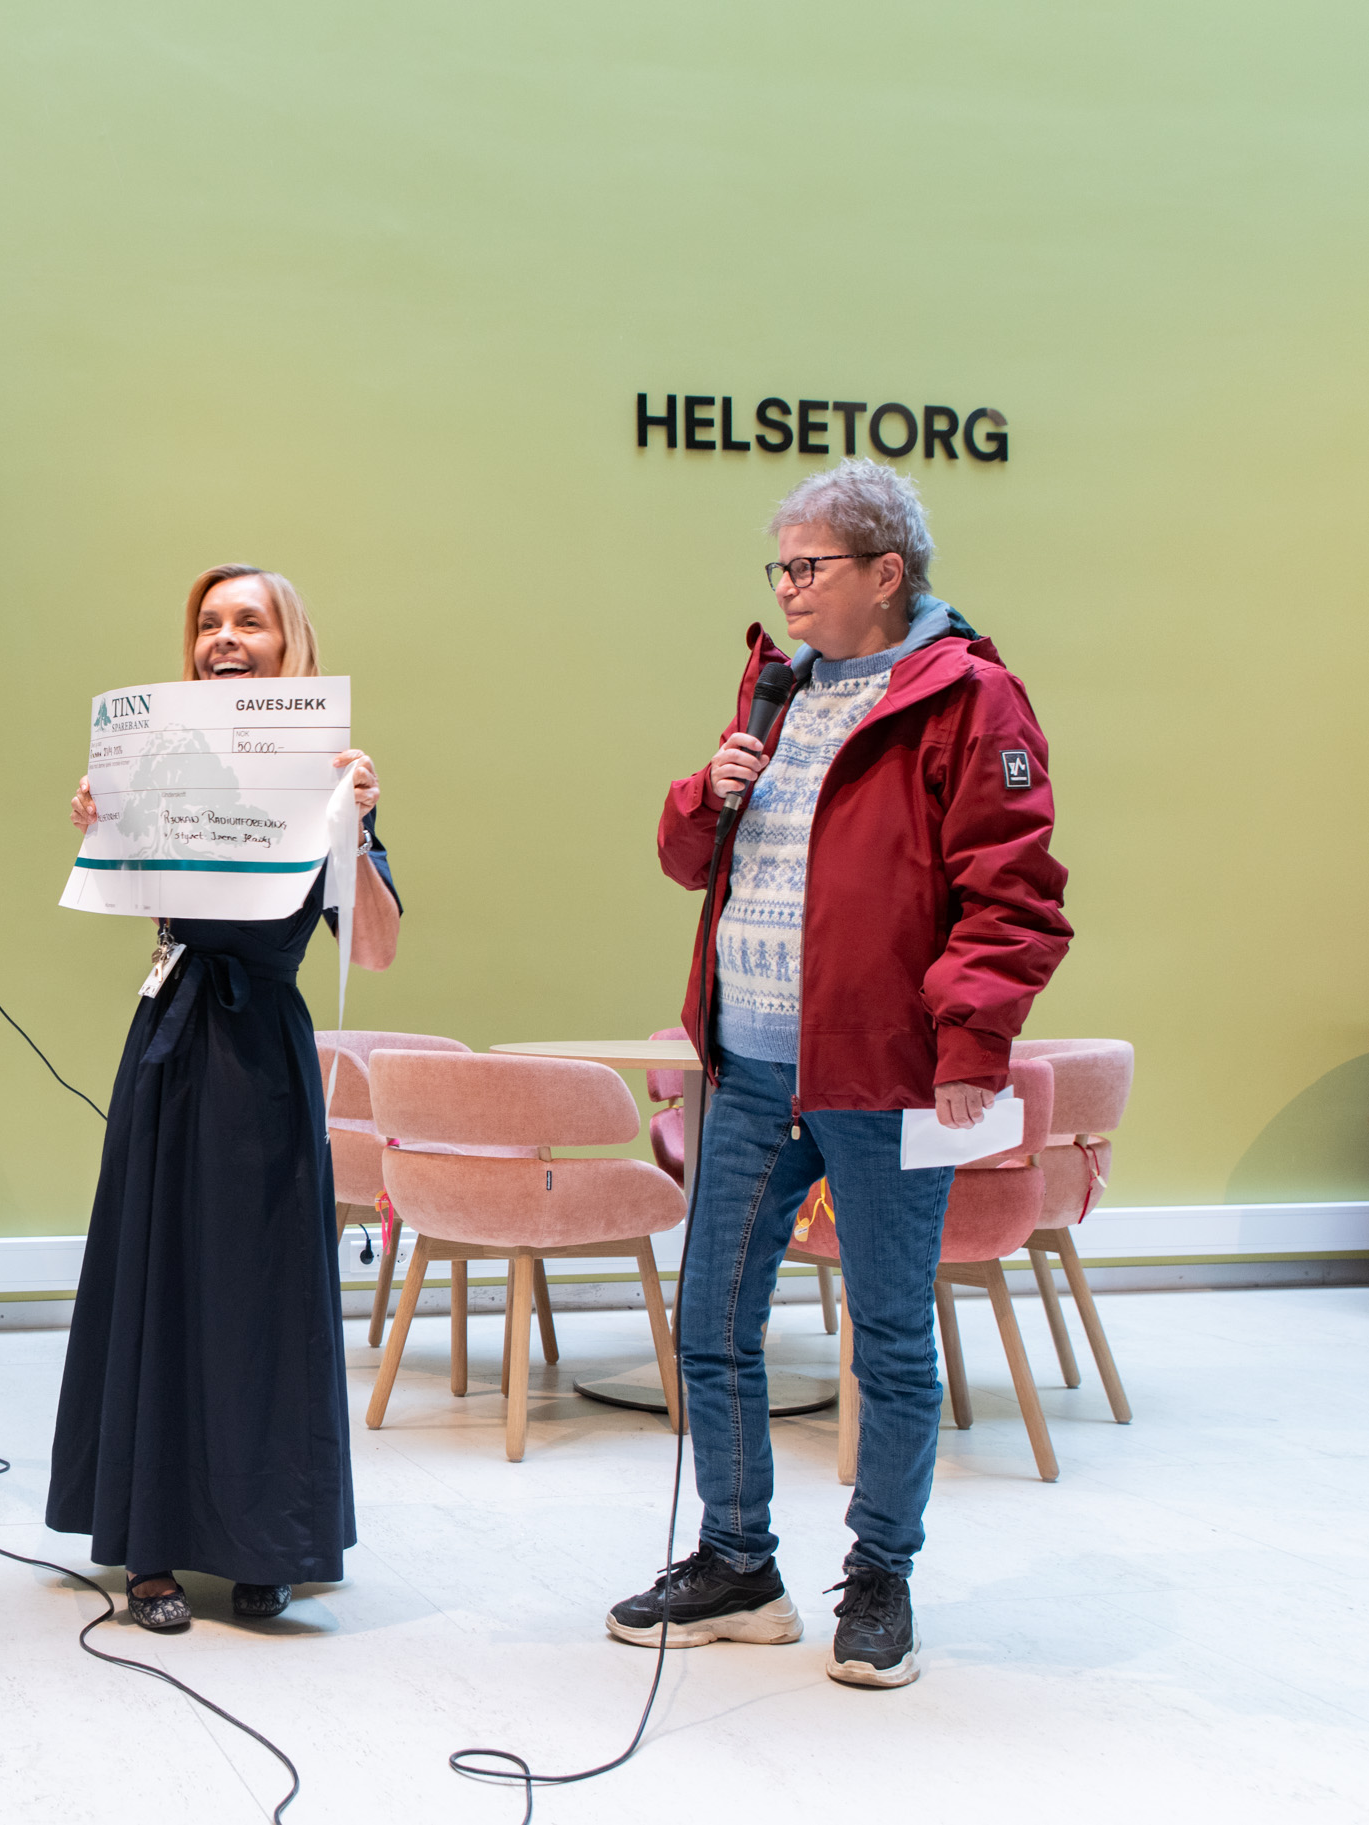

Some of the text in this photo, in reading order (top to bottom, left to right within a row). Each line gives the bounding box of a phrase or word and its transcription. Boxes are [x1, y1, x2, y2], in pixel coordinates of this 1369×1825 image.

[637, 392, 1010, 462] HELSETORG
[111, 693, 151, 718] TINN
[235, 698, 327, 712] GAVESJEKK
[111, 719, 150, 733] SPAREBANK
